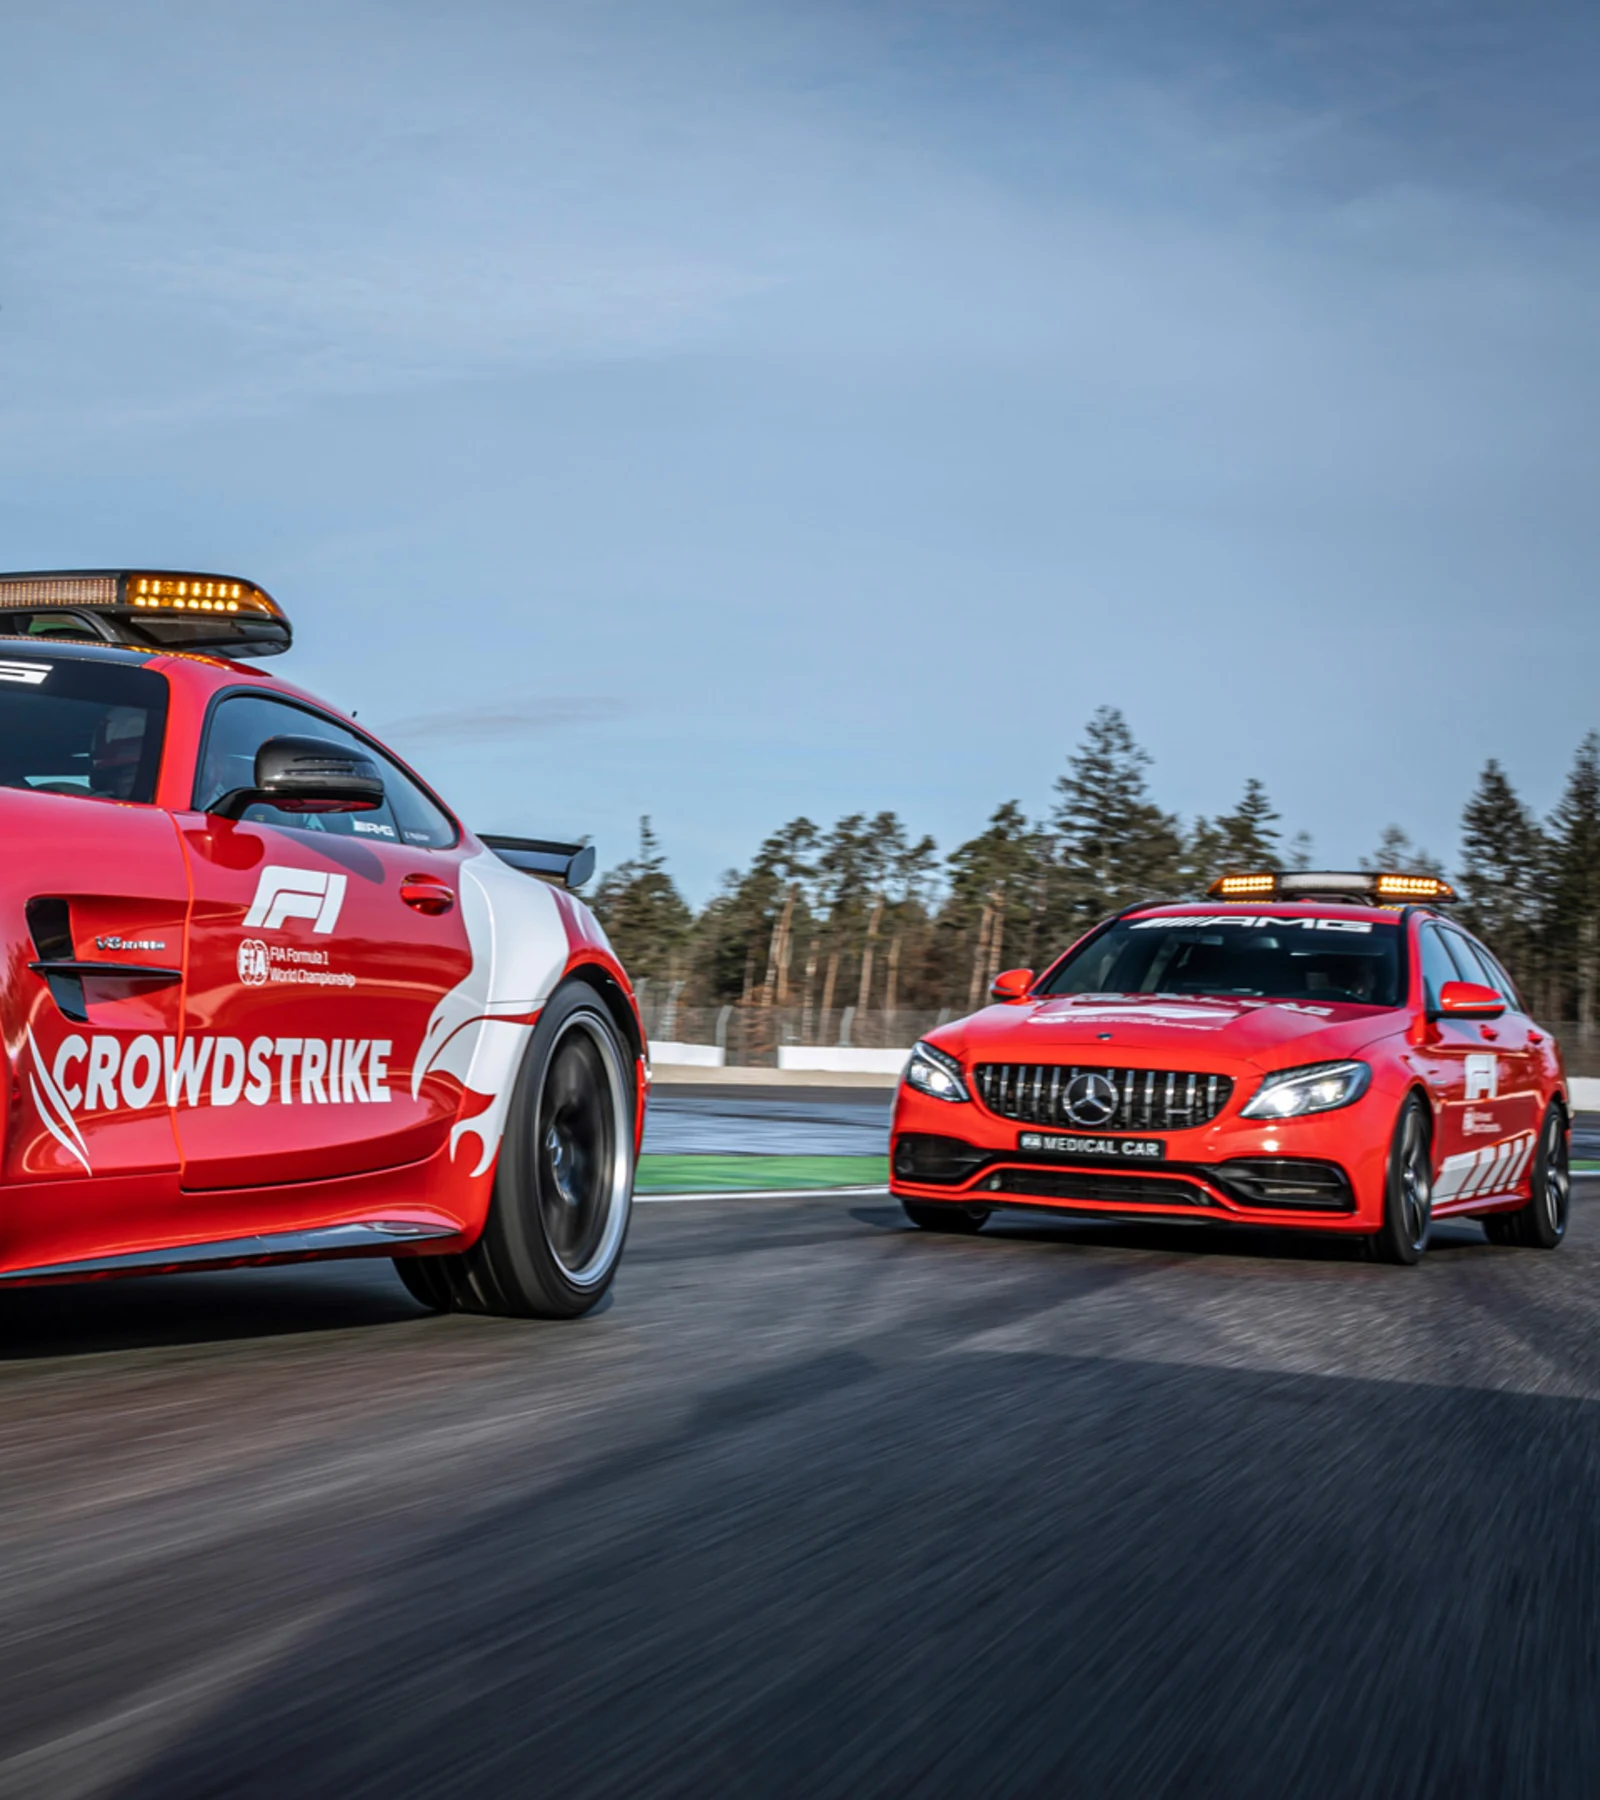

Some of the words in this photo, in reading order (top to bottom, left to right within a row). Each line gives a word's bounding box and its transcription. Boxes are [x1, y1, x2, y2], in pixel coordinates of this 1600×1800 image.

[242, 865, 348, 934] F1
[1202, 915, 1373, 933] AMG
[270, 946, 286, 962] FIA
[286, 948, 323, 965] Formula
[323, 951, 329, 966] 1
[270, 967, 297, 982] World
[298, 969, 357, 989] Championship
[53, 1034, 393, 1110] CROWDSTRIKE
[1043, 1137, 1118, 1154] MEDICAL
[1121, 1140, 1159, 1155] CAR
